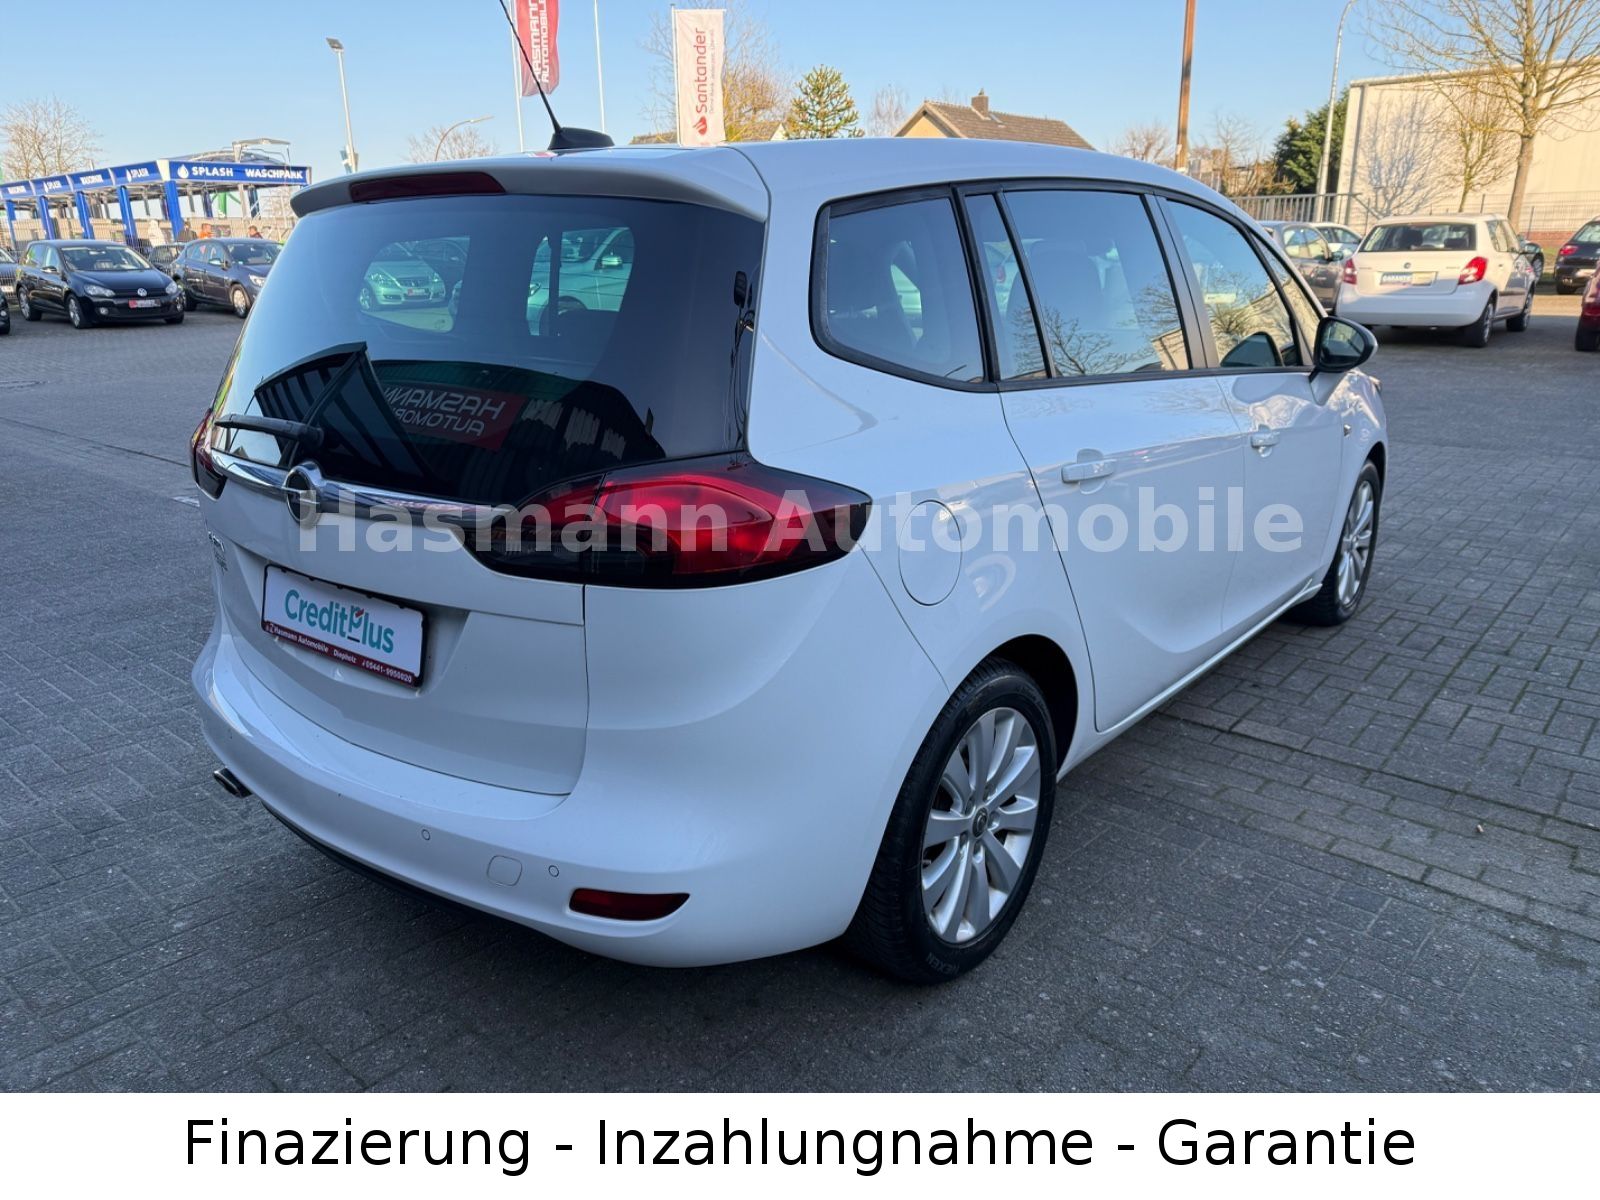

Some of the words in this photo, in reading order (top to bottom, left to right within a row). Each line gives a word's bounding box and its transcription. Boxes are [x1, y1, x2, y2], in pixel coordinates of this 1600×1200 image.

[692, 27, 708, 114] Santander
[191, 166, 233, 177] SPLASH
[245, 168, 303, 180] WASCHPARK
[285, 589, 395, 654] CreditPlus
